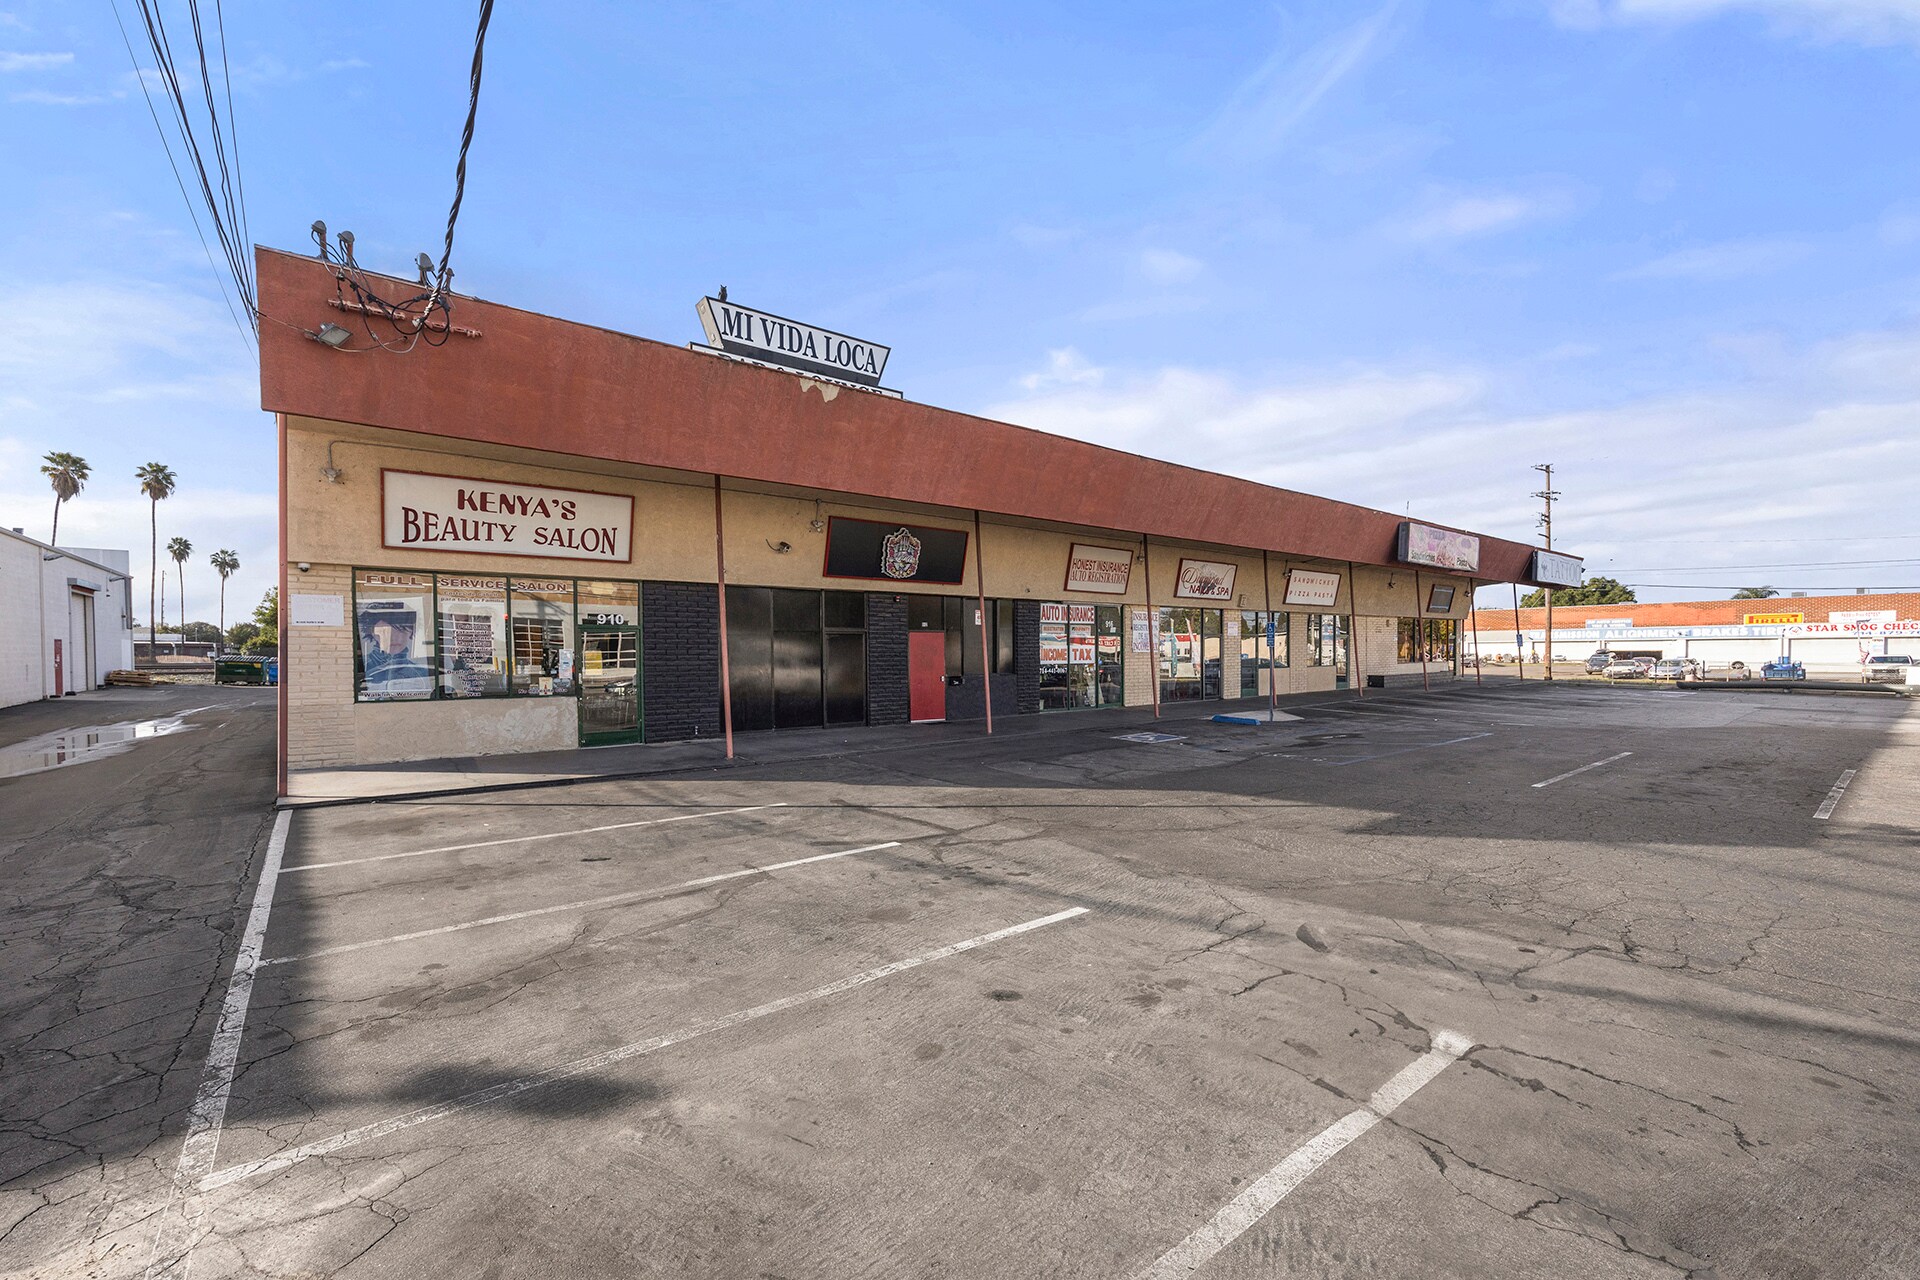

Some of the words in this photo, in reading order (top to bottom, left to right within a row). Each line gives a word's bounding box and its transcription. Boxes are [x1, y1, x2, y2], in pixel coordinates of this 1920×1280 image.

[720, 306, 755, 343] MI
[759, 317, 820, 360] VIDA
[823, 335, 879, 376] LOCA
[457, 488, 577, 521] KENYA'S
[401, 506, 517, 544] BEAUTY
[533, 526, 618, 556] SALON
[1071, 558, 1097, 571] HONEST
[1096, 560, 1129, 574] INSURANCE
[365, 574, 423, 587] FULL
[440, 578, 504, 590] SERVICE
[517, 581, 568, 592] SALON
[1070, 570, 1087, 582] AUTO
[1088, 571, 1127, 585] REGISTRATION
[1216, 586, 1230, 597] SPA
[1313, 591, 1334, 599] PASTA
[597, 613, 625, 626] 910
[1041, 605, 1060, 622] AUTO
[1061, 606, 1094, 622] INSURANCE
[1748, 614, 1800, 625] PIRELLI
[1692, 626, 1749, 637] BRAKES
[1806, 624, 1839, 633] STAR
[1843, 623, 1878, 632] SMOG
[1883, 622, 1920, 631] CHEC
[1040, 648, 1067, 662] INCOME
[1071, 648, 1093, 661] TAX
